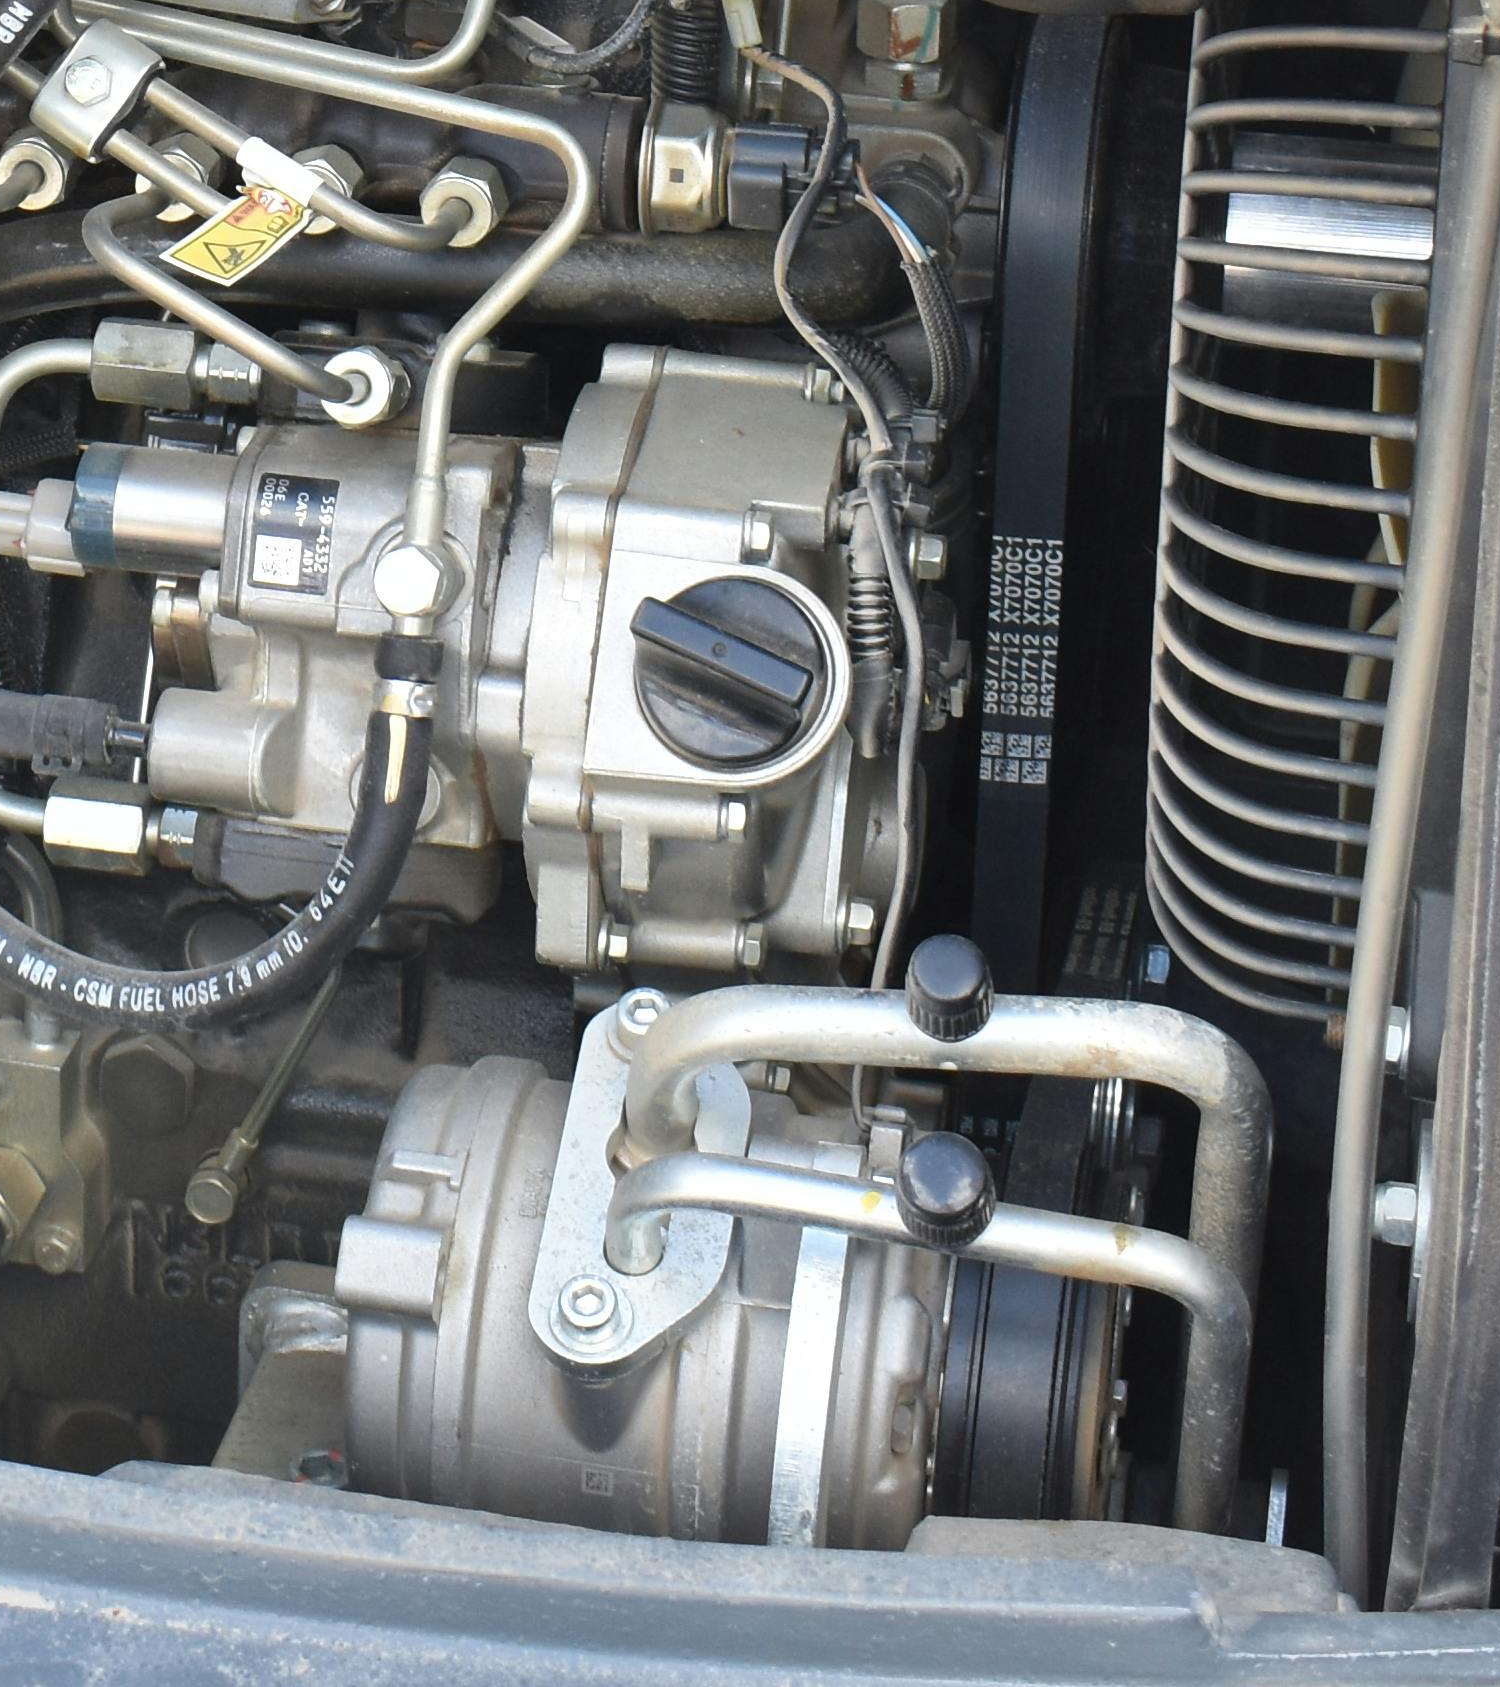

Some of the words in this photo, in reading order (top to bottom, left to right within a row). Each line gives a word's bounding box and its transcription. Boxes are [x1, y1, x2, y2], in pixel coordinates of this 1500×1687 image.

[313, 495, 336, 574] 559-4332
[1003, 535, 1023, 625] X7070C1
[1022, 536, 1043, 626] X7070C1
[1042, 538, 1064, 627] X7070C1
[1000, 632, 1020, 717] 5637712
[1020, 633, 1040, 719] 5637712
[17, 953, 57, 991] NBR
[73, 977, 114, 1009] CSM
[119, 986, 165, 1012] FUEL
[171, 976, 221, 1009] HOSE
[225, 968, 252, 996] 7.9
[256, 950, 284, 981] mm
